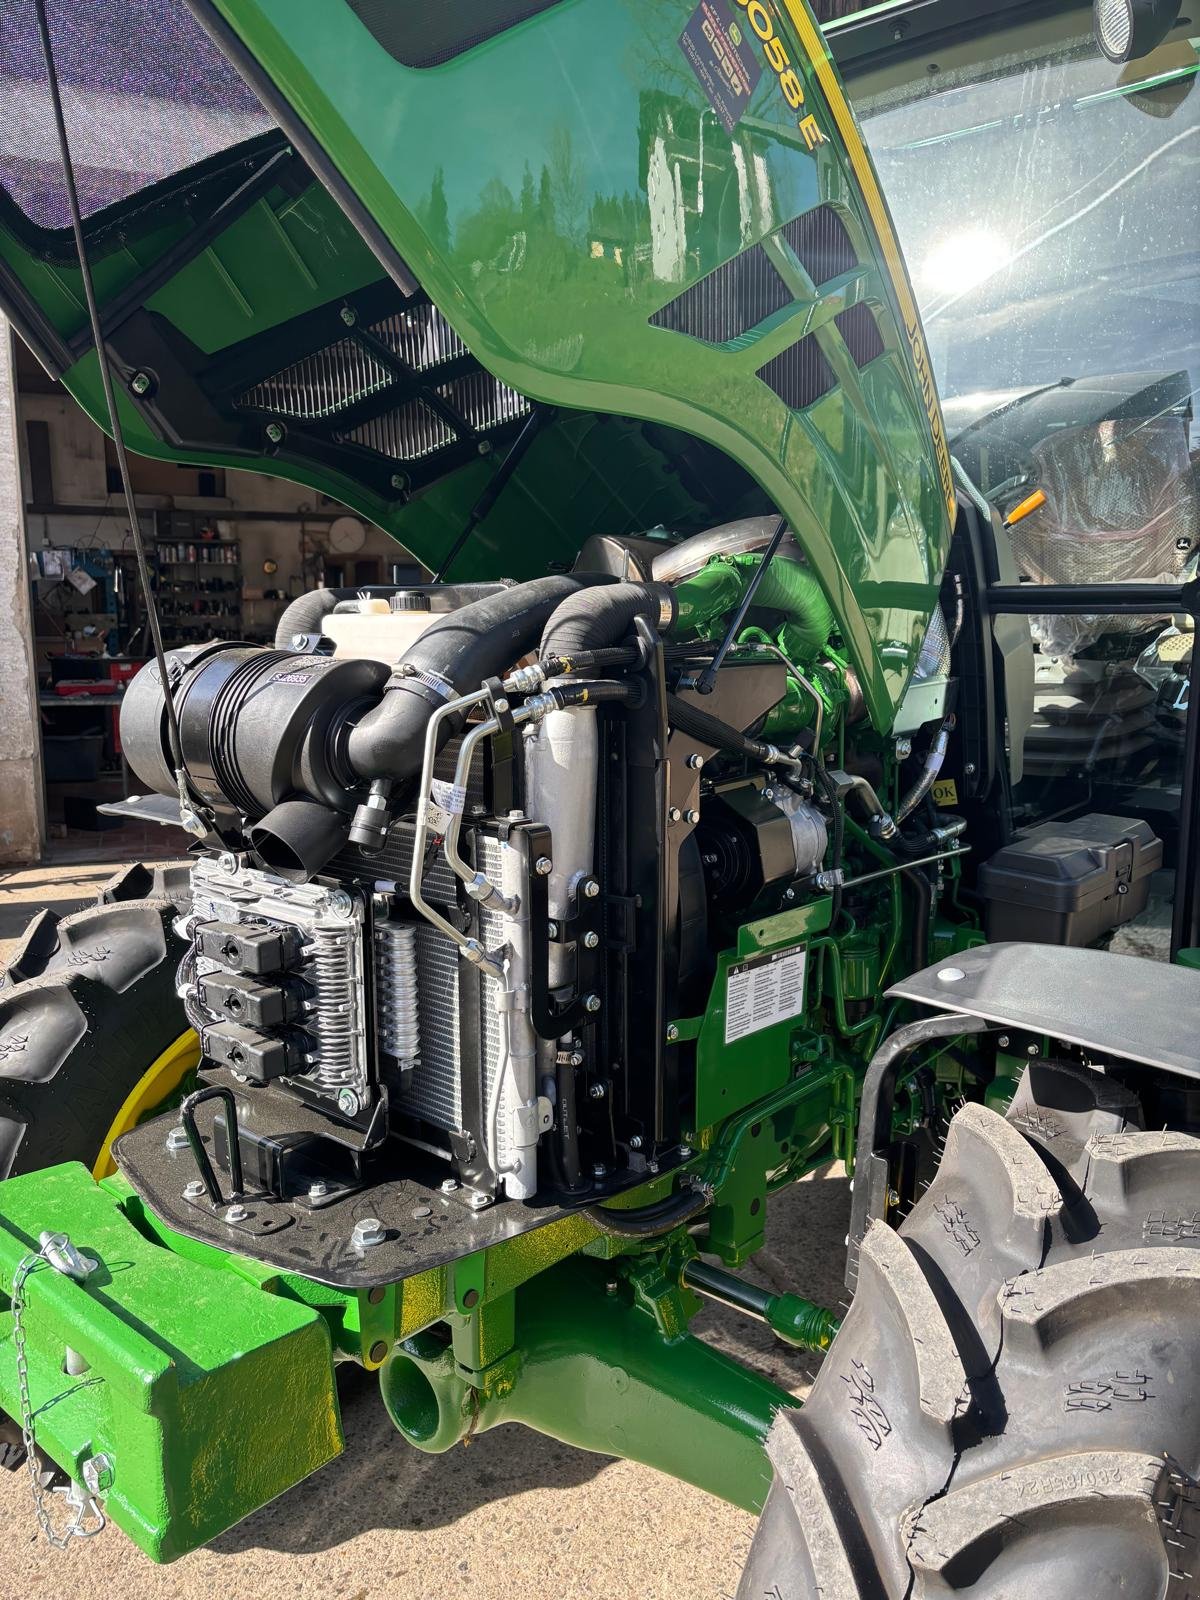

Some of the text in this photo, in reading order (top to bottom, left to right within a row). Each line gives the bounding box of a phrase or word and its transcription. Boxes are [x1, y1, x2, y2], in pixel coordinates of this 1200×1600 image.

[736, 0, 824, 151] 058 E
[906, 323, 952, 511] JOHN DEERE
[933, 787, 955, 799] OK
